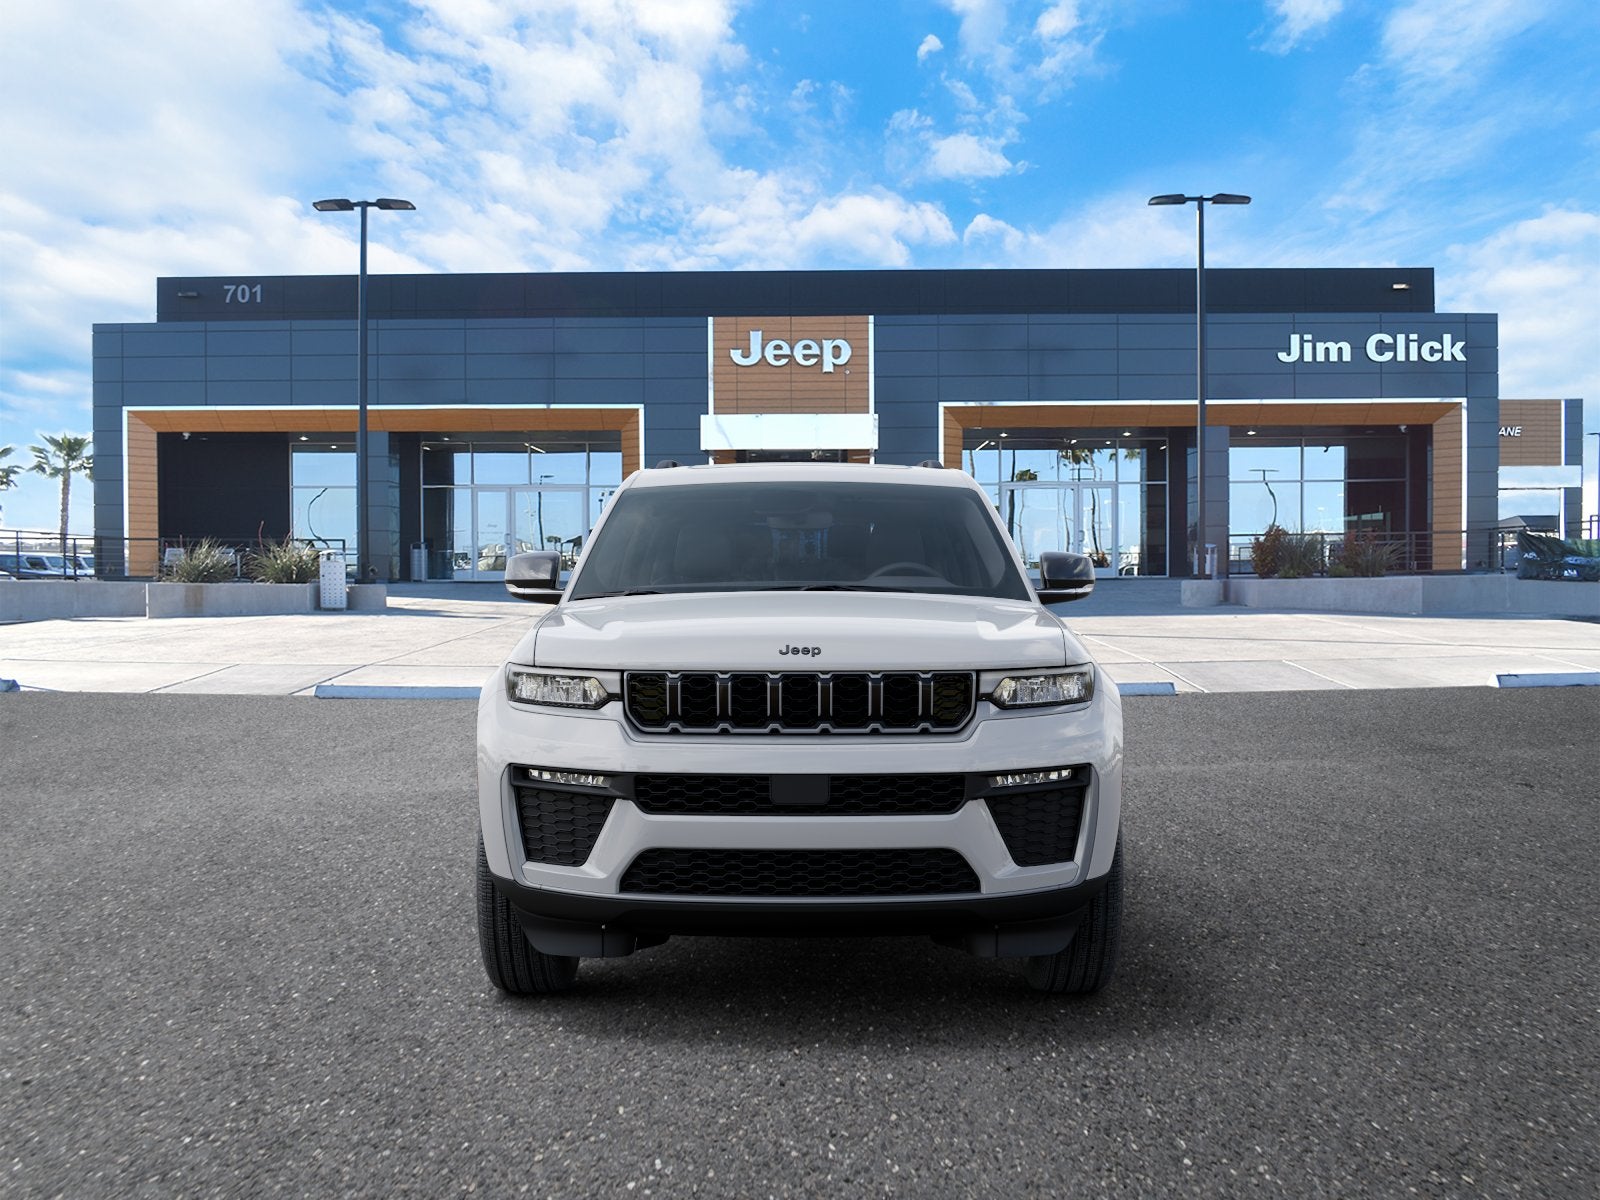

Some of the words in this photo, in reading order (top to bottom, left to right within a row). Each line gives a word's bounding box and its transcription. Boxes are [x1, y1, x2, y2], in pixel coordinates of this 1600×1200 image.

[223, 284, 262, 304] 701
[729, 329, 852, 374] Jeep
[1277, 333, 1352, 363] Jim
[1366, 333, 1467, 362] Click
[778, 644, 822, 658] Jeep
